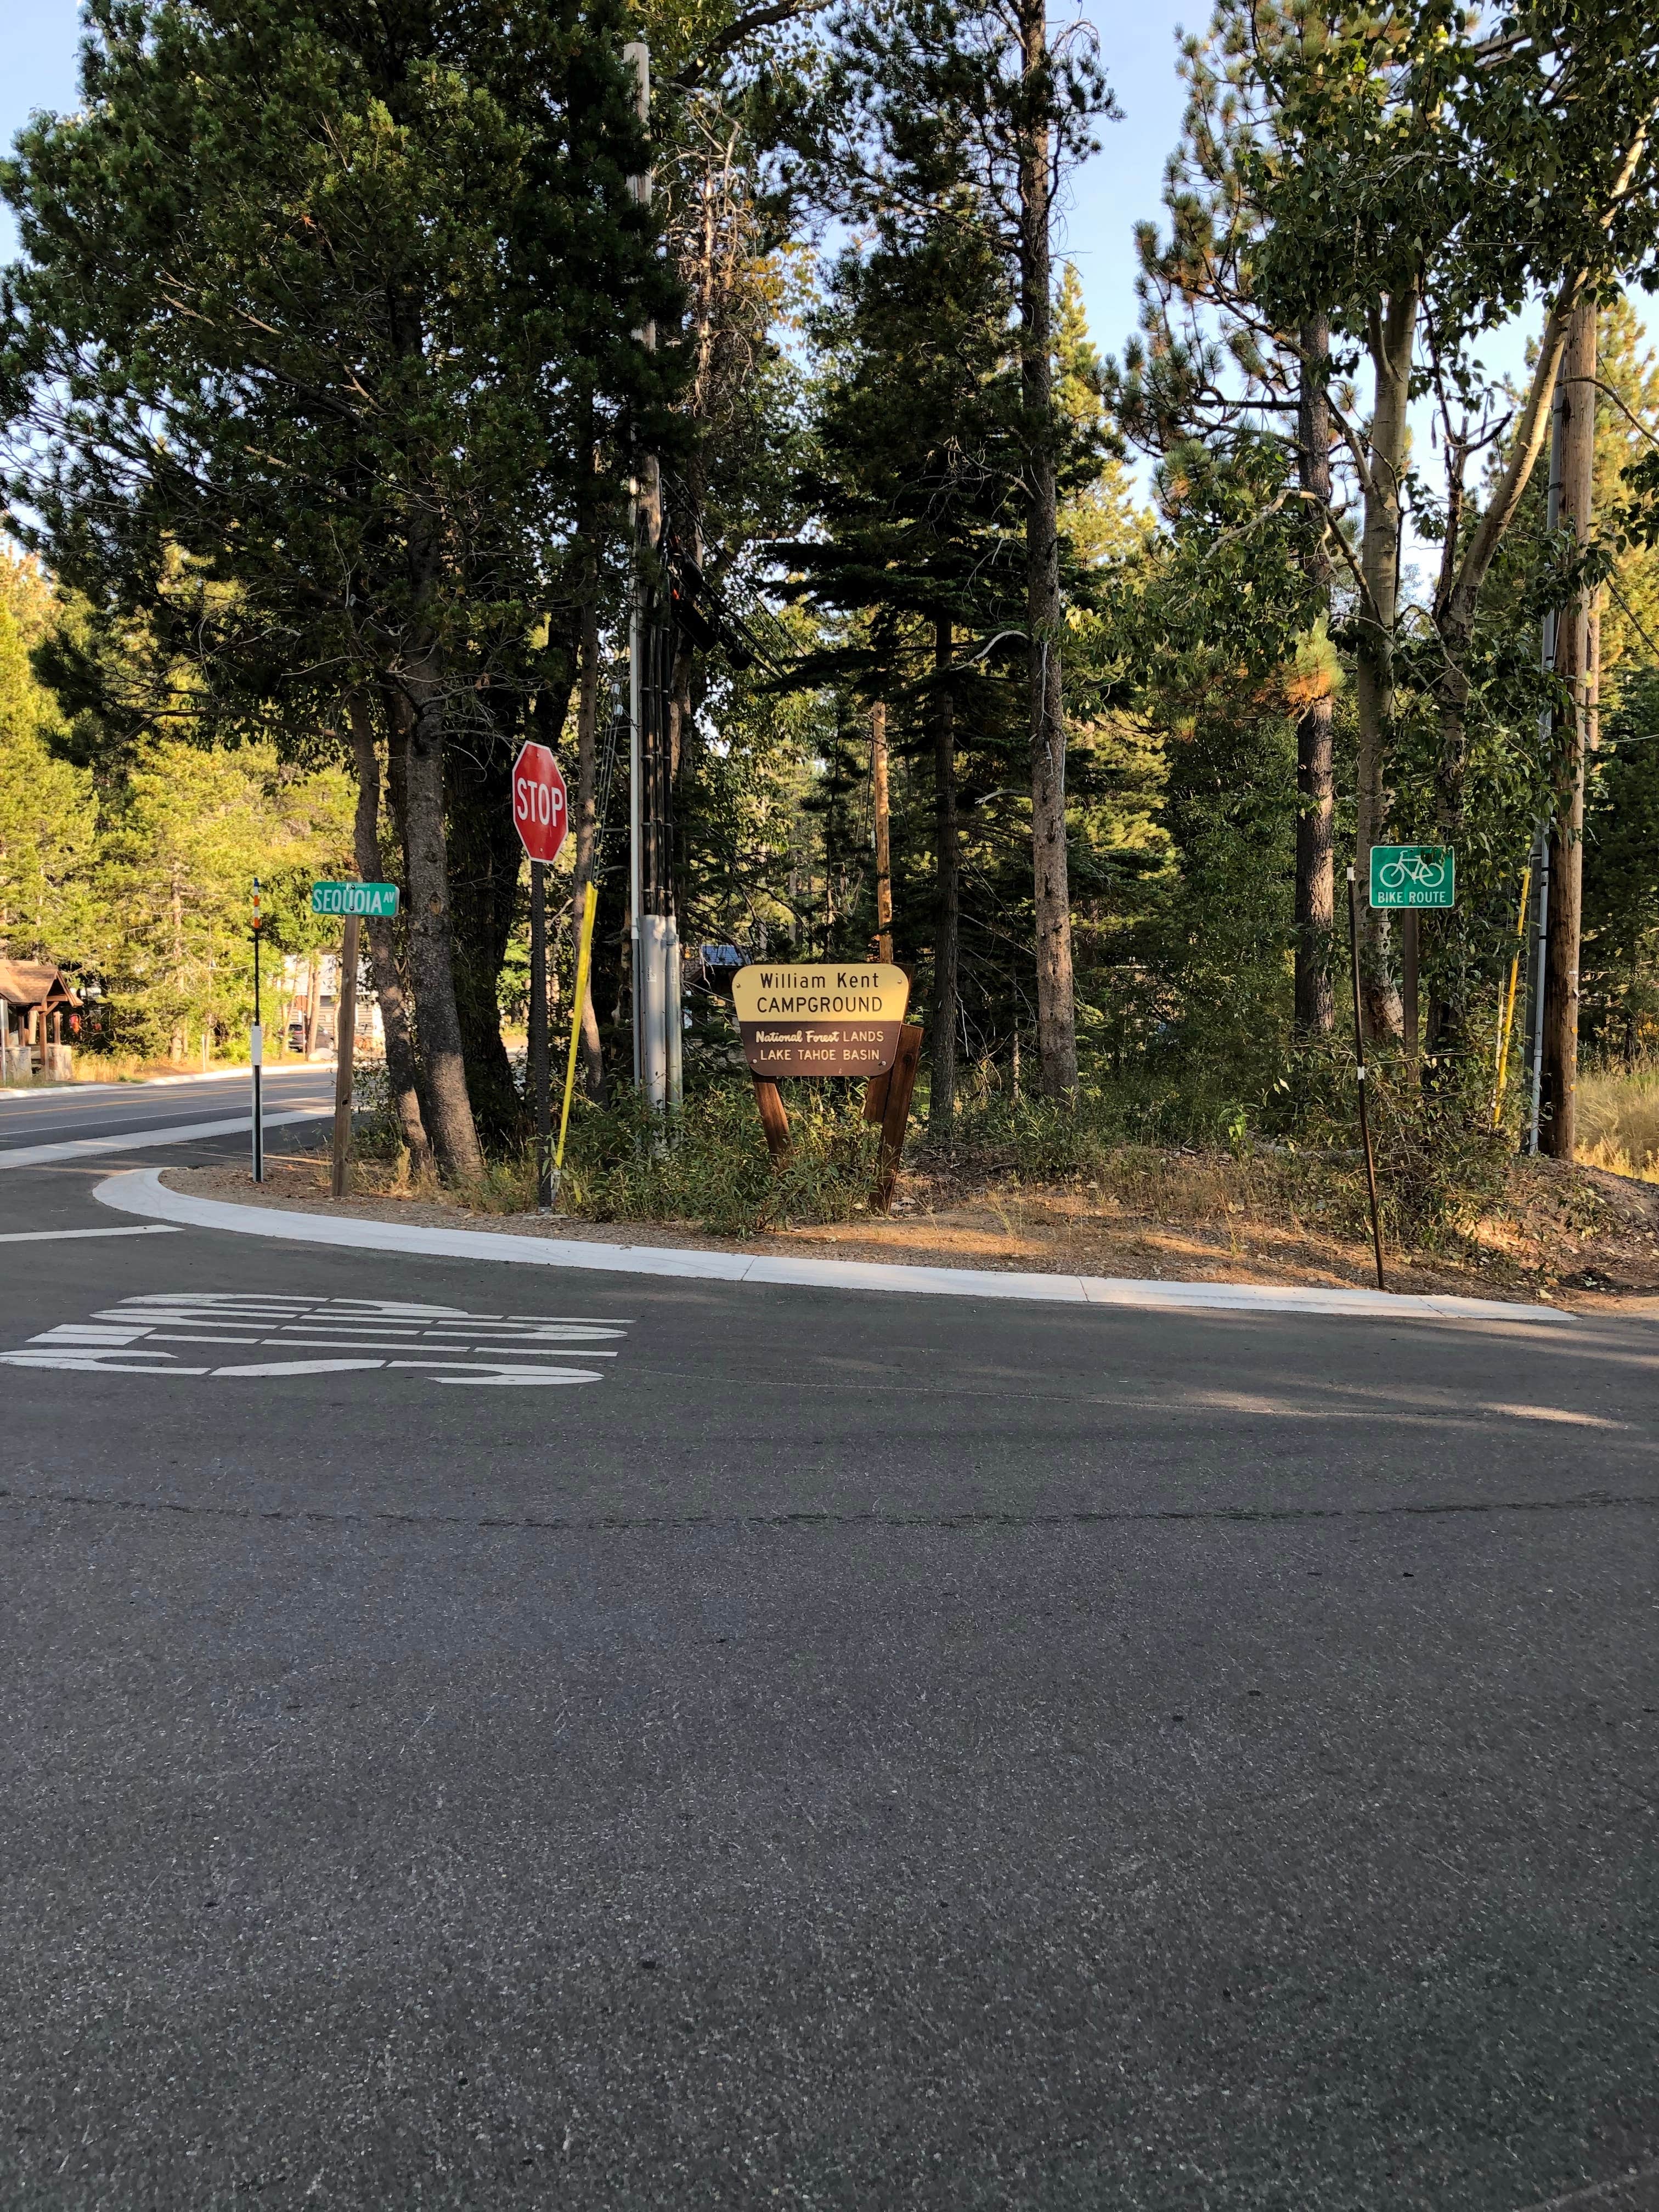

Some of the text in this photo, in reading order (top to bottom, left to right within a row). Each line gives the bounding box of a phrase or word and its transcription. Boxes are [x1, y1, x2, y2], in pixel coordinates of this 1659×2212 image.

[517, 777, 563, 827] STOP
[313, 889, 394, 913] SEQUOIA AV
[1378, 891, 1446, 904] BIKE ROUTE
[760, 972, 879, 989] William Kent
[757, 997, 882, 1013] CAMPGROUND
[755, 1030, 884, 1043] National Forest LANDS
[760, 1049, 880, 1061] LAKE TAHOE BASIN
[0, 1293, 636, 1386] STOP
